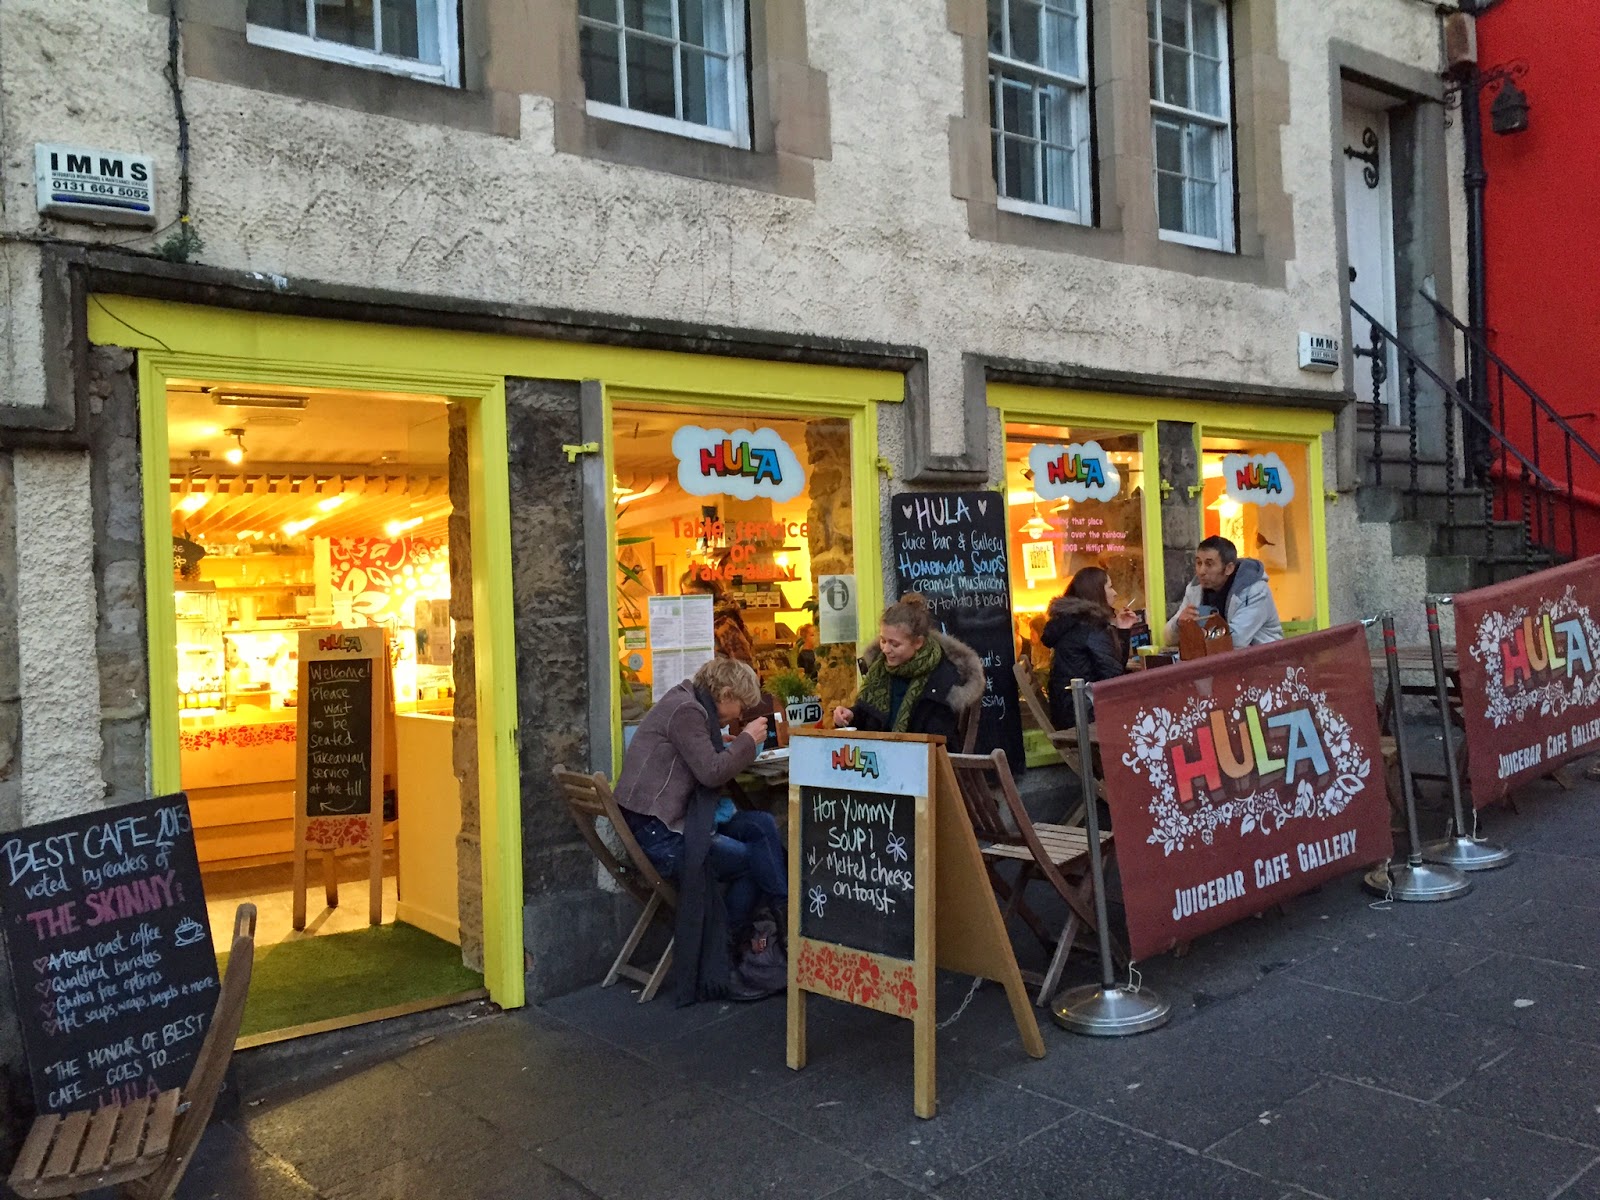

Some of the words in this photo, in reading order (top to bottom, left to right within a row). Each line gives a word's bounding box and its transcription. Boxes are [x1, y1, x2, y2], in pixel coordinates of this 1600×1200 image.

[50, 152, 148, 181] IMMS
[52, 181, 84, 191] 0131
[90, 184, 114, 195] 664
[118, 187, 149, 199] 5052
[1311, 337, 1338, 351] IMMS
[700, 440, 783, 486] HULA
[1046, 452, 1105, 489] HULA
[1236, 462, 1283, 494] HULA
[915, 496, 972, 532] HULA
[1087, 517, 1104, 527] place
[672, 516, 725, 539] Table
[735, 517, 811, 542] service
[898, 531, 926, 551] Juice
[931, 529, 952, 551] Bar
[1089, 531, 1100, 539] the
[730, 544, 757, 563] or
[898, 552, 965, 580] Homemade
[971, 551, 1005, 576] Soups
[940, 591, 973, 609] tomato
[982, 592, 1009, 611] bean
[318, 634, 363, 653] HULA
[1502, 614, 1593, 688] HULA
[310, 661, 371, 681] Welcome!
[310, 687, 350, 701] Please
[311, 719, 323, 730] to
[333, 717, 348, 731] be
[324, 703, 353, 716] wait
[309, 752, 366, 771] Takeaway
[831, 743, 880, 780] HULA
[1170, 705, 1331, 806] HULA
[1497, 743, 1543, 780] JUICEBAR
[1546, 731, 1568, 759] CAFE
[309, 784, 321, 794] at
[324, 782, 342, 796] the
[346, 779, 363, 796] till
[312, 767, 350, 780] service
[0, 831, 79, 887] BEST
[83, 815, 156, 859] CAFE
[24, 866, 72, 900] voted
[82, 865, 103, 891] by
[103, 852, 149, 878] readers
[826, 850, 867, 882] Melted
[870, 857, 915, 892] cheese
[1172, 869, 1247, 922] JUICEBAR
[1253, 852, 1292, 890] CAFE
[1296, 828, 1358, 874] GALLERY
[833, 881, 852, 899] on
[26, 900, 82, 942] THE
[85, 868, 177, 927] SKINNY
[47, 945, 97, 972] Artisan
[95, 930, 129, 958] roast
[129, 922, 164, 948] coffee
[51, 962, 110, 993] Qualified
[113, 947, 162, 976] baristas
[55, 989, 95, 1015] Gluten
[97, 985, 119, 1002] free
[123, 970, 163, 995] options
[56, 1010, 83, 1034] Hot
[150, 984, 179, 1009] bagels
[142, 1031, 159, 1051] OF
[161, 1013, 206, 1048] BEST
[106, 1058, 144, 1087] GOES
